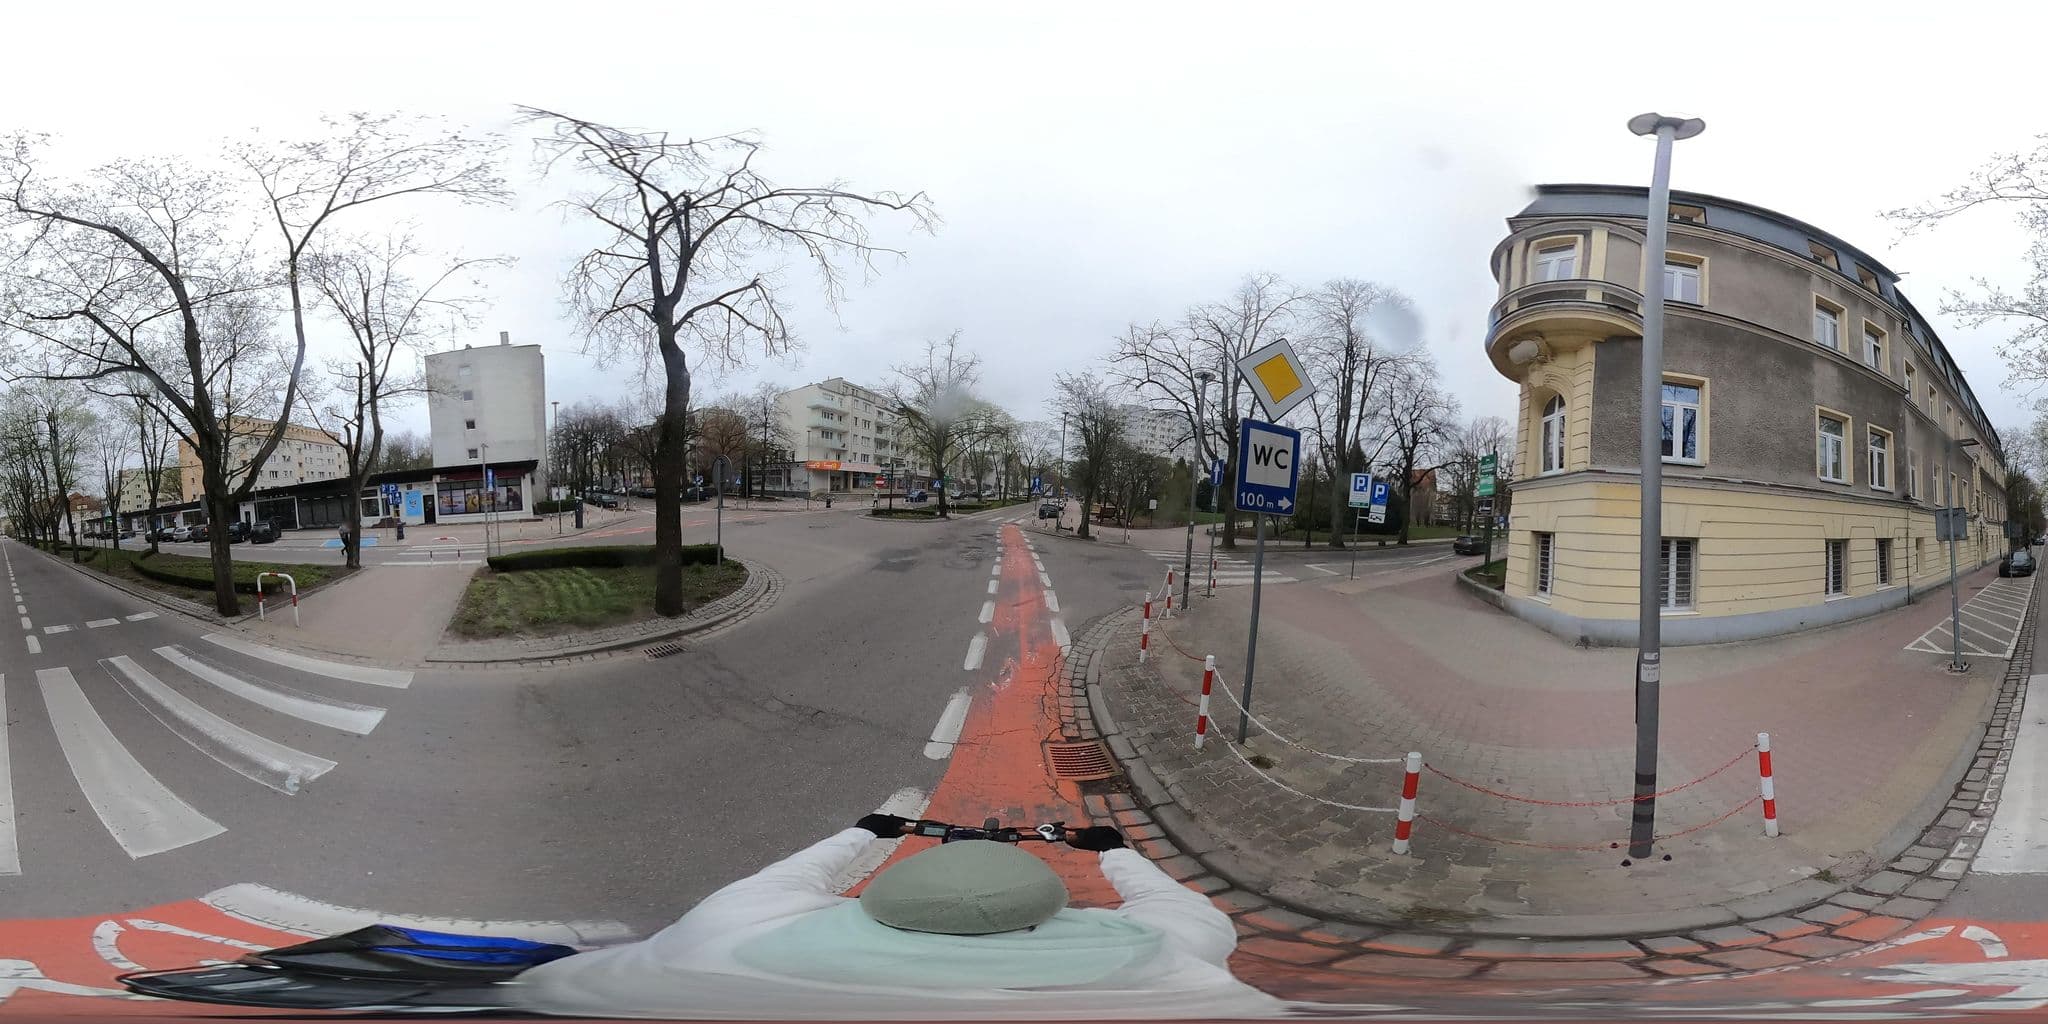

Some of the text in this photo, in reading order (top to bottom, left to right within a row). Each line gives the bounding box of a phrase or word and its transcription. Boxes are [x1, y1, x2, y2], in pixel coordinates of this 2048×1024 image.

[1253, 443, 1289, 470] WC
[1356, 476, 1366, 490] P
[1374, 484, 1385, 498] P
[1240, 492, 1274, 509] 100 m
